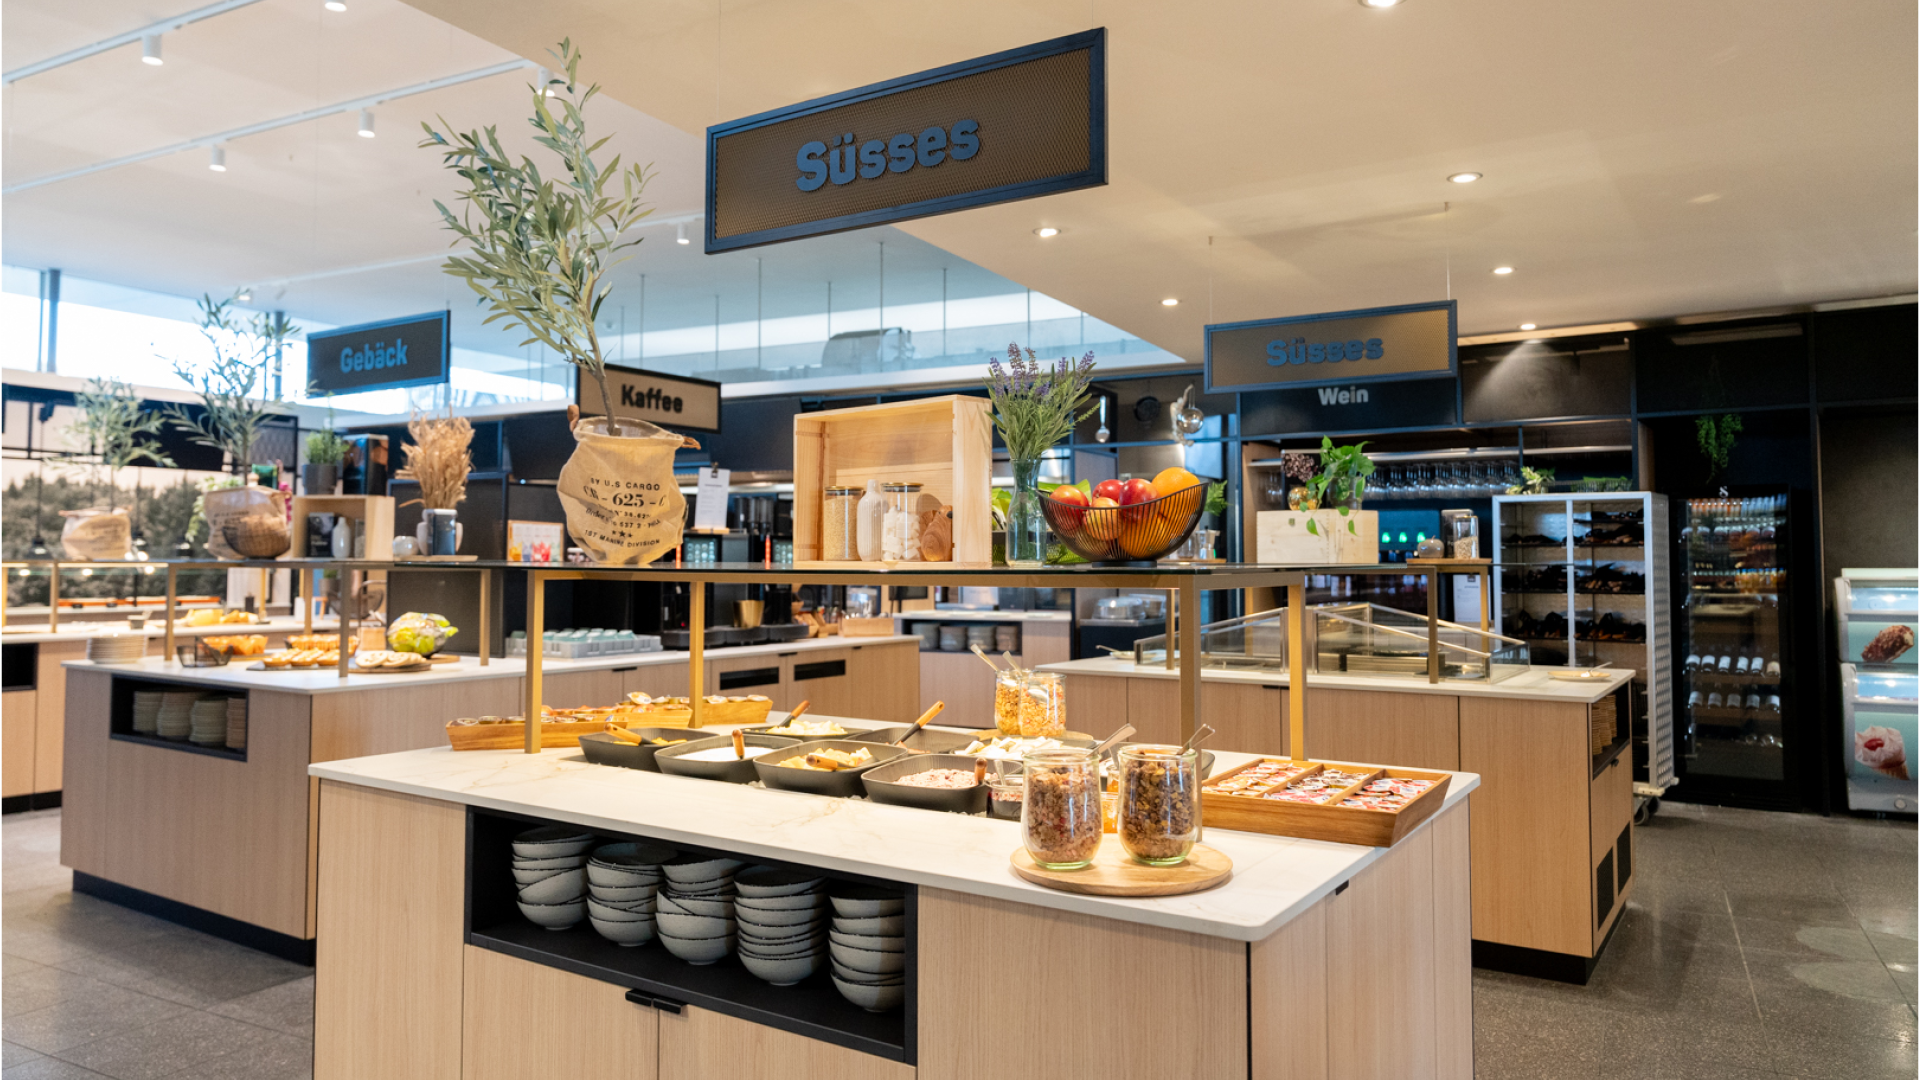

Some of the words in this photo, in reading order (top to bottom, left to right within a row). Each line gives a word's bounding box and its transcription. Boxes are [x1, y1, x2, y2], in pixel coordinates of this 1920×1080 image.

[796, 119, 980, 191] Süsses
[340, 338, 408, 373] Gebäck
[1266, 337, 1384, 366] Süsses
[621, 384, 683, 413] Kaffee
[1318, 385, 1369, 406] Wein
[625, 481, 661, 491] CARGO
[612, 492, 645, 507] 625
[627, 539, 660, 548] DIVISION
